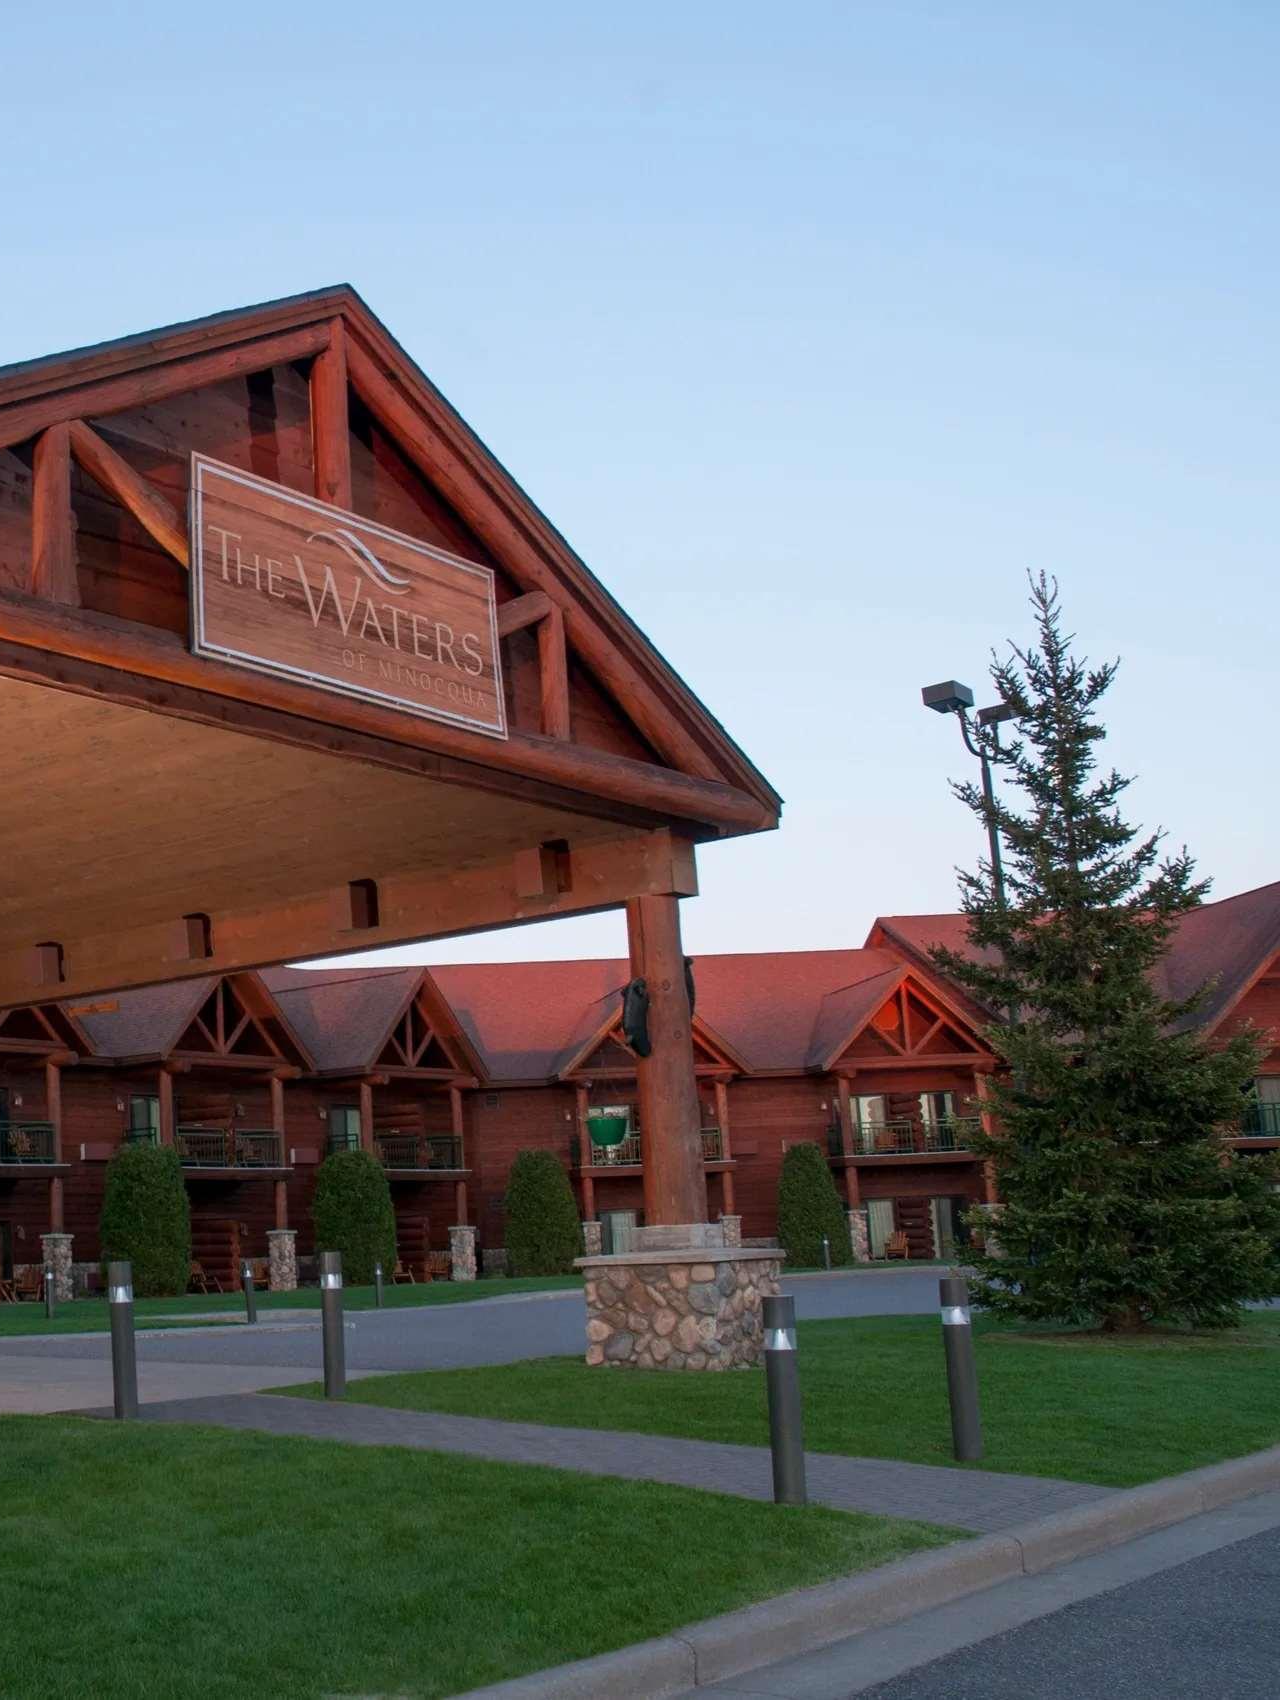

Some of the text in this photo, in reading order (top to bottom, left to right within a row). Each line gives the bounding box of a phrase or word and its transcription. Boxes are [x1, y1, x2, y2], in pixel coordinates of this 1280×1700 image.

[207, 525, 484, 677] THE WATERS
[341, 648, 368, 673] OF
